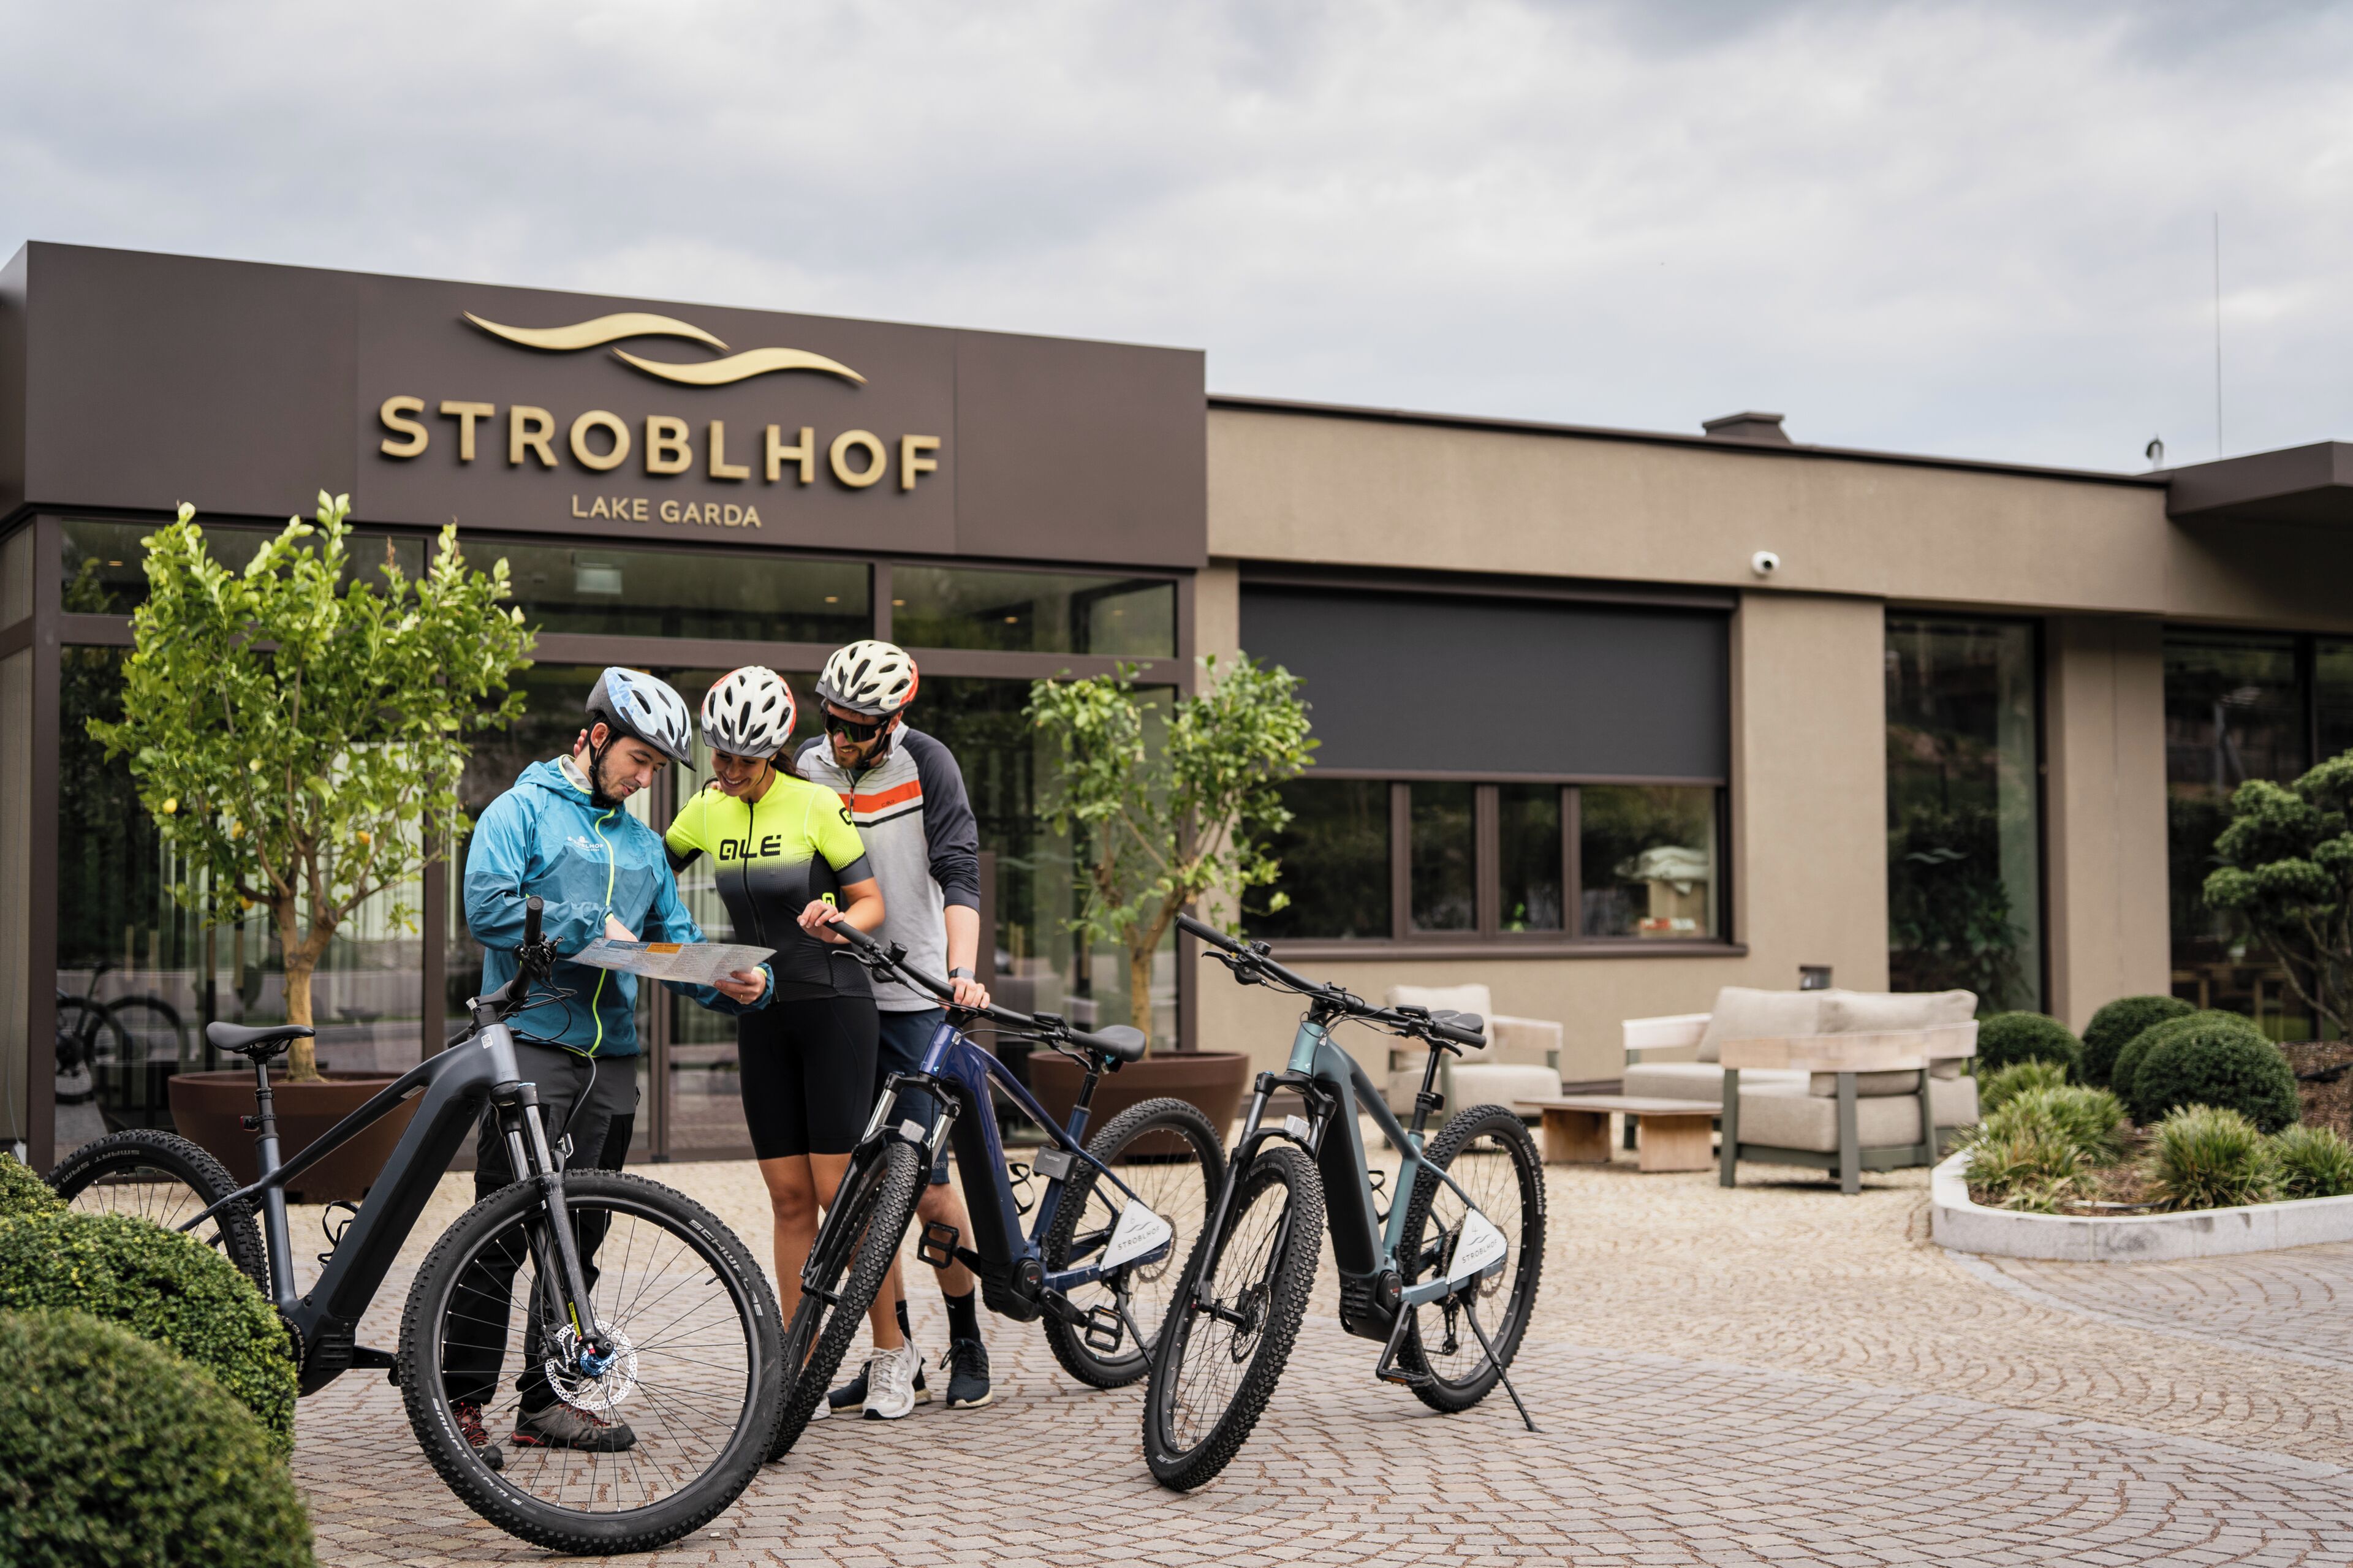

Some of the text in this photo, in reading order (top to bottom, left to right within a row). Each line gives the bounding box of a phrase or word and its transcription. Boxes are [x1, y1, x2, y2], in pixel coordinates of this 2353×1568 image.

[379, 395, 941, 489] STROBLHOF
[572, 494, 762, 528] LAKE GARDA
[62, 1149, 140, 1183] SMART SAM
[1533, 1170, 1543, 1214] SMART
[1118, 1225, 1161, 1251] STROBLHOF
[1462, 1239, 1498, 1263] STROBLHOF
[433, 1398, 471, 1461] SMART
